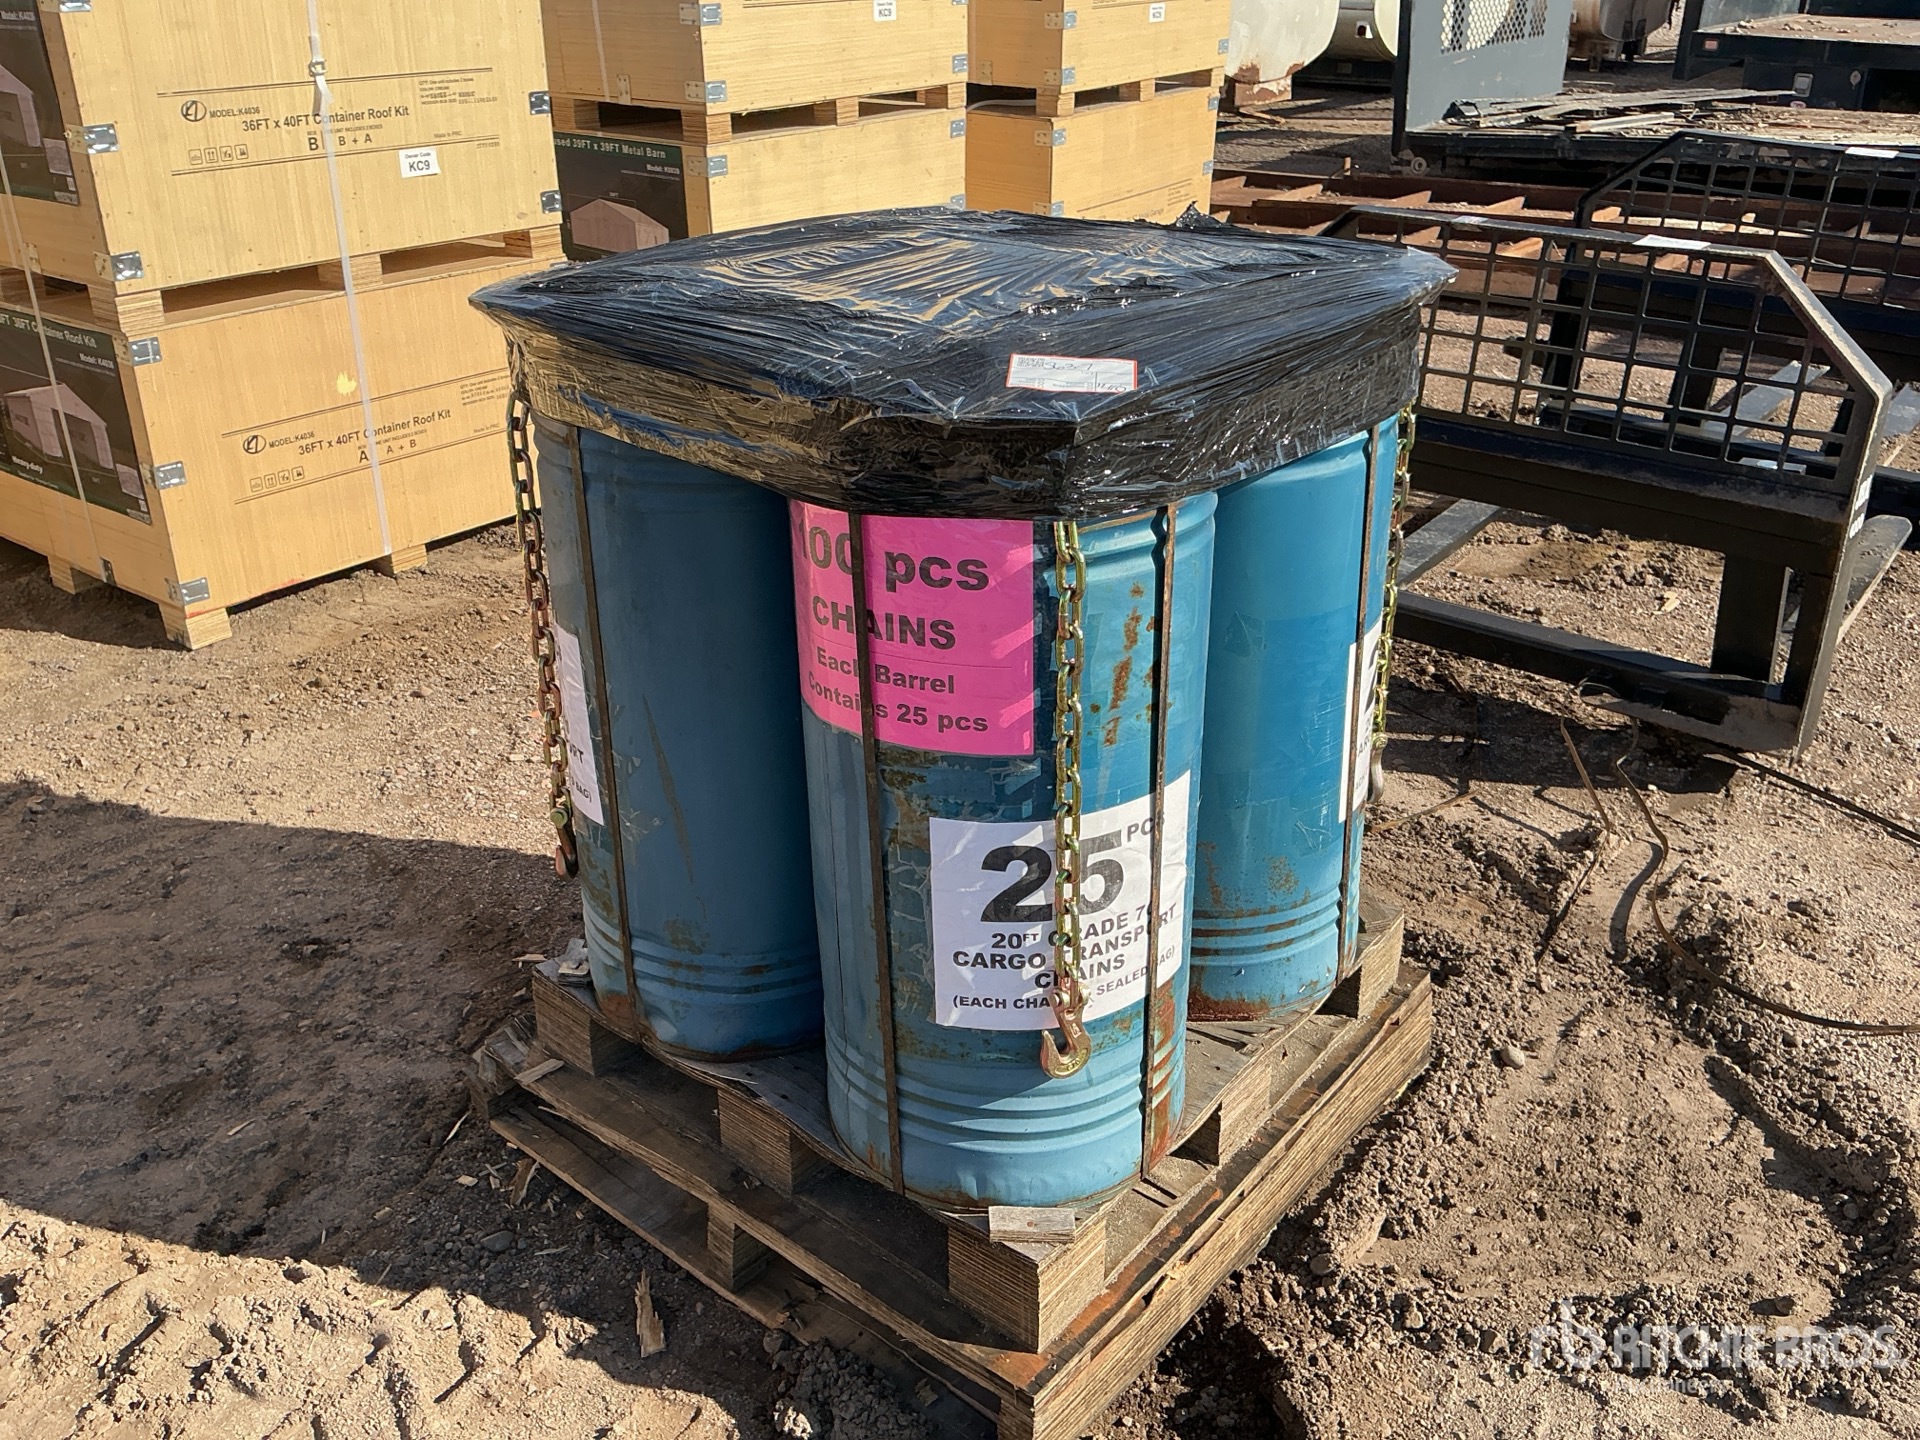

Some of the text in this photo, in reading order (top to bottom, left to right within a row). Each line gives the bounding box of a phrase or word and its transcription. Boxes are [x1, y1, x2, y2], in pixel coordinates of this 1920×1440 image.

[242, 119, 270, 131] 36FT
[273, 119, 280, 129] x
[283, 115, 310, 127] 40FT
[368, 107, 392, 120] Roof
[394, 105, 410, 117] Kit
[308, 137, 319, 151] B
[338, 135, 347, 147] B
[364, 133, 373, 144] A
[622, 144, 645, 156] Metal
[646, 147, 666, 159] Barn
[409, 160, 431, 172] KC9
[269, 431, 315, 449] MODEL:K4036
[298, 440, 324, 456] 36FT
[327, 440, 334, 449] x
[336, 430, 361, 446] 40FT
[412, 411, 436, 427] Roof
[437, 408, 452, 421] Kit
[359, 450, 370, 463] A
[386, 445, 394, 455] A
[410, 439, 417, 449] B
[884, 551, 989, 593] pcs
[812, 596, 956, 650] CHAINS
[875, 663, 955, 694] Barrel
[808, 671, 989, 733] Contais 25 pcs
[980, 814, 1164, 923] 25 PC
[1048, 911, 1128, 946] GADE
[953, 951, 1046, 970] CARGO
[953, 944, 1176, 1010] (EACH CHA SEALED AG)
